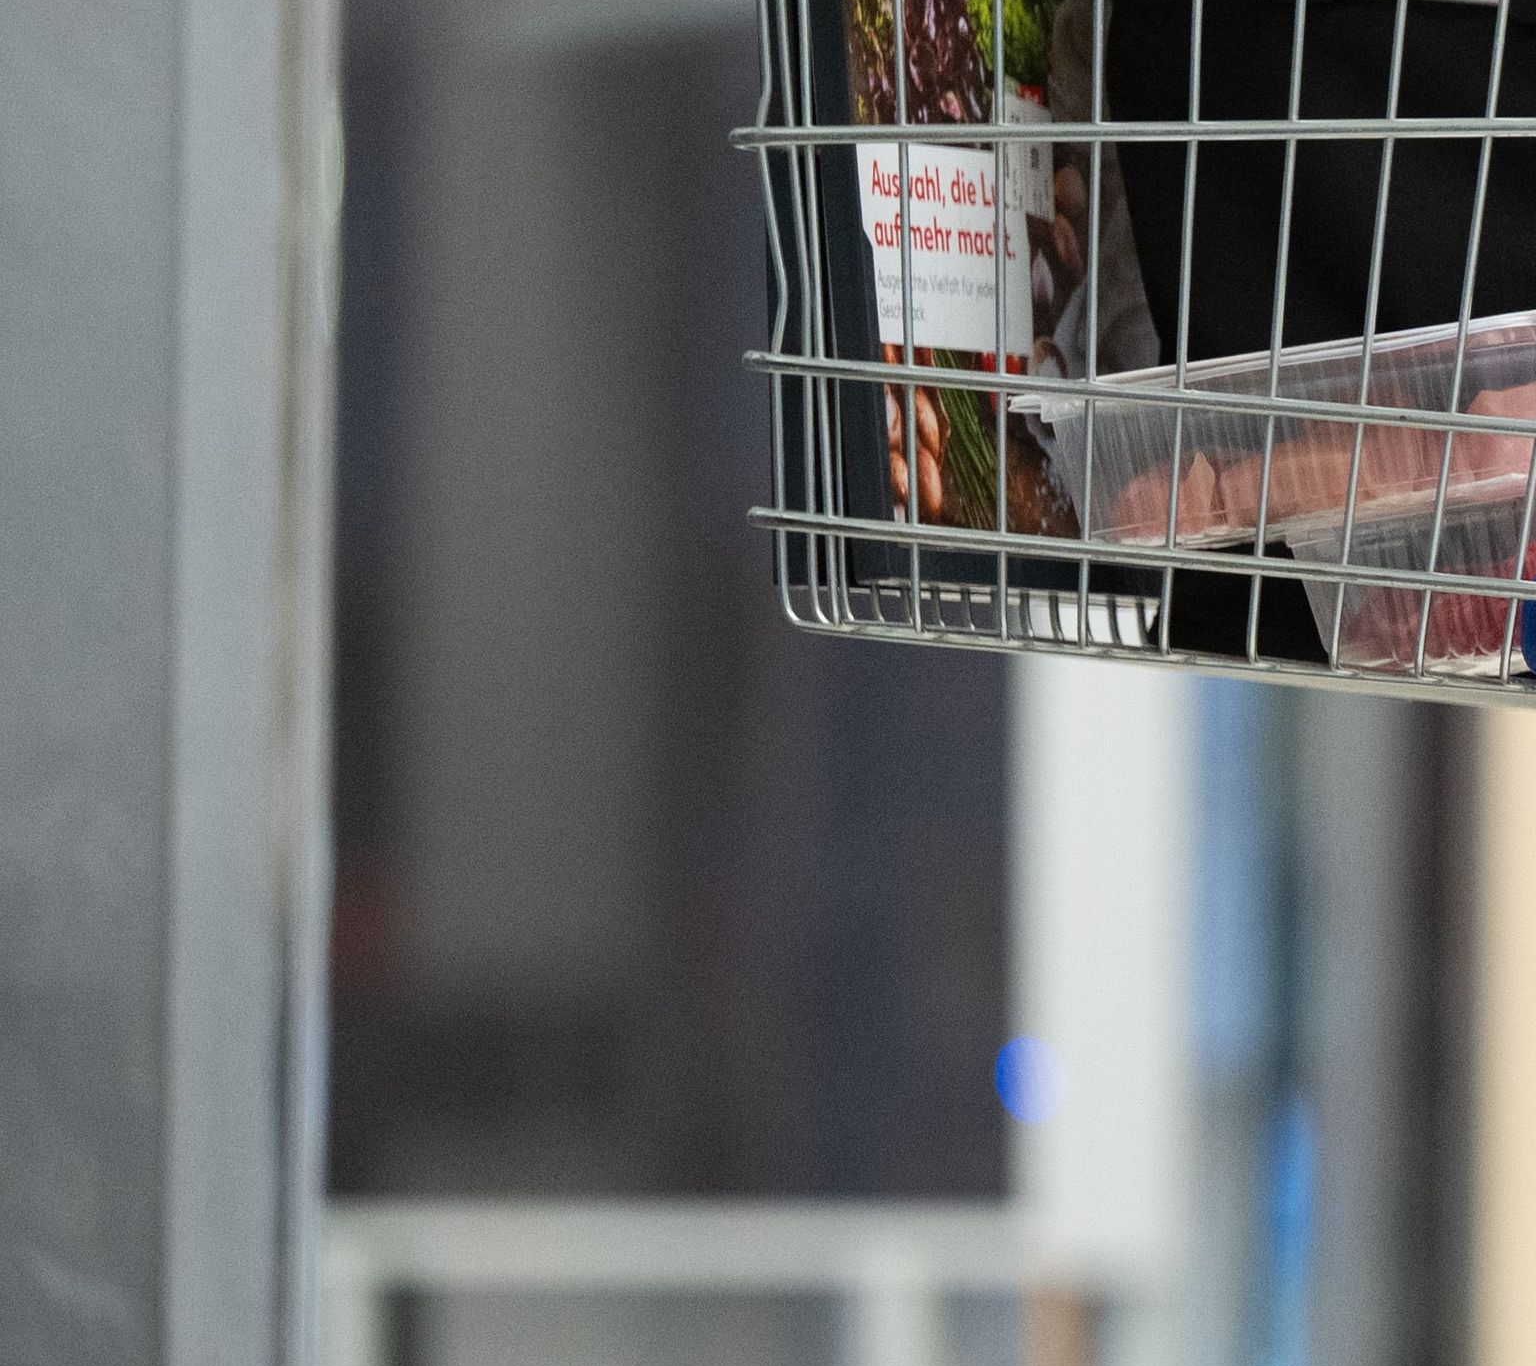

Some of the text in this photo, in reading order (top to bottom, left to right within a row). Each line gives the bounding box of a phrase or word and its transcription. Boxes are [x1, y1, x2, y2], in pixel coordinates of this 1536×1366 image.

[950, 167, 976, 205] die
[874, 212, 903, 248] auf
[909, 215, 952, 254] mehr
